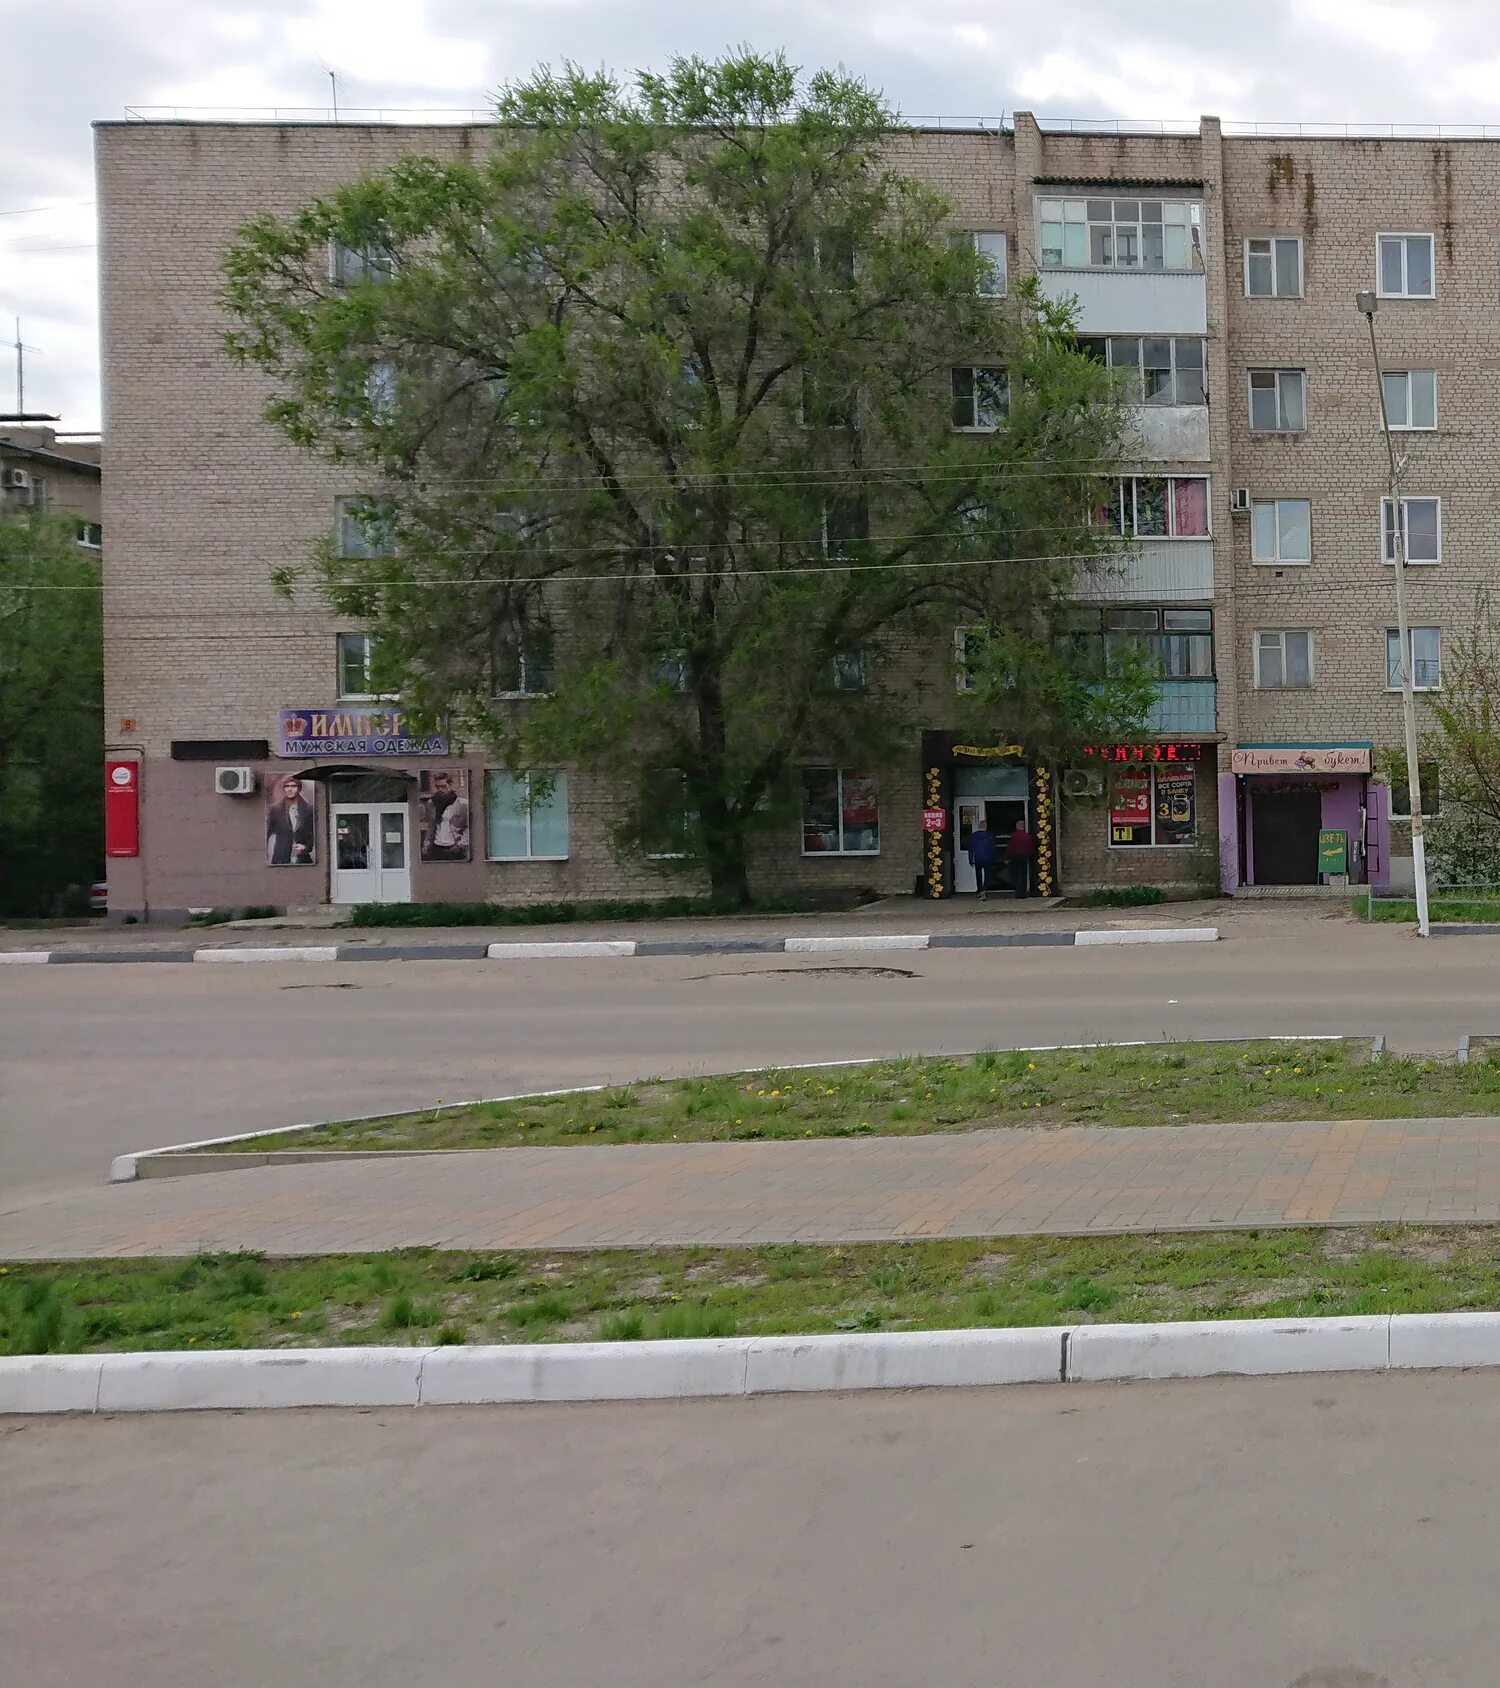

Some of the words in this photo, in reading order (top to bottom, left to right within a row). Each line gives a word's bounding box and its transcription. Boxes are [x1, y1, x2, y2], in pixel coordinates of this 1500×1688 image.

[285, 740, 366, 753] МУЖСКАЯ
[374, 739, 443, 754] ОДЕЖДА
[1233, 751, 1288, 768] Привет
[1324, 750, 1367, 768] букет!
[1159, 803, 1169, 816] 3
